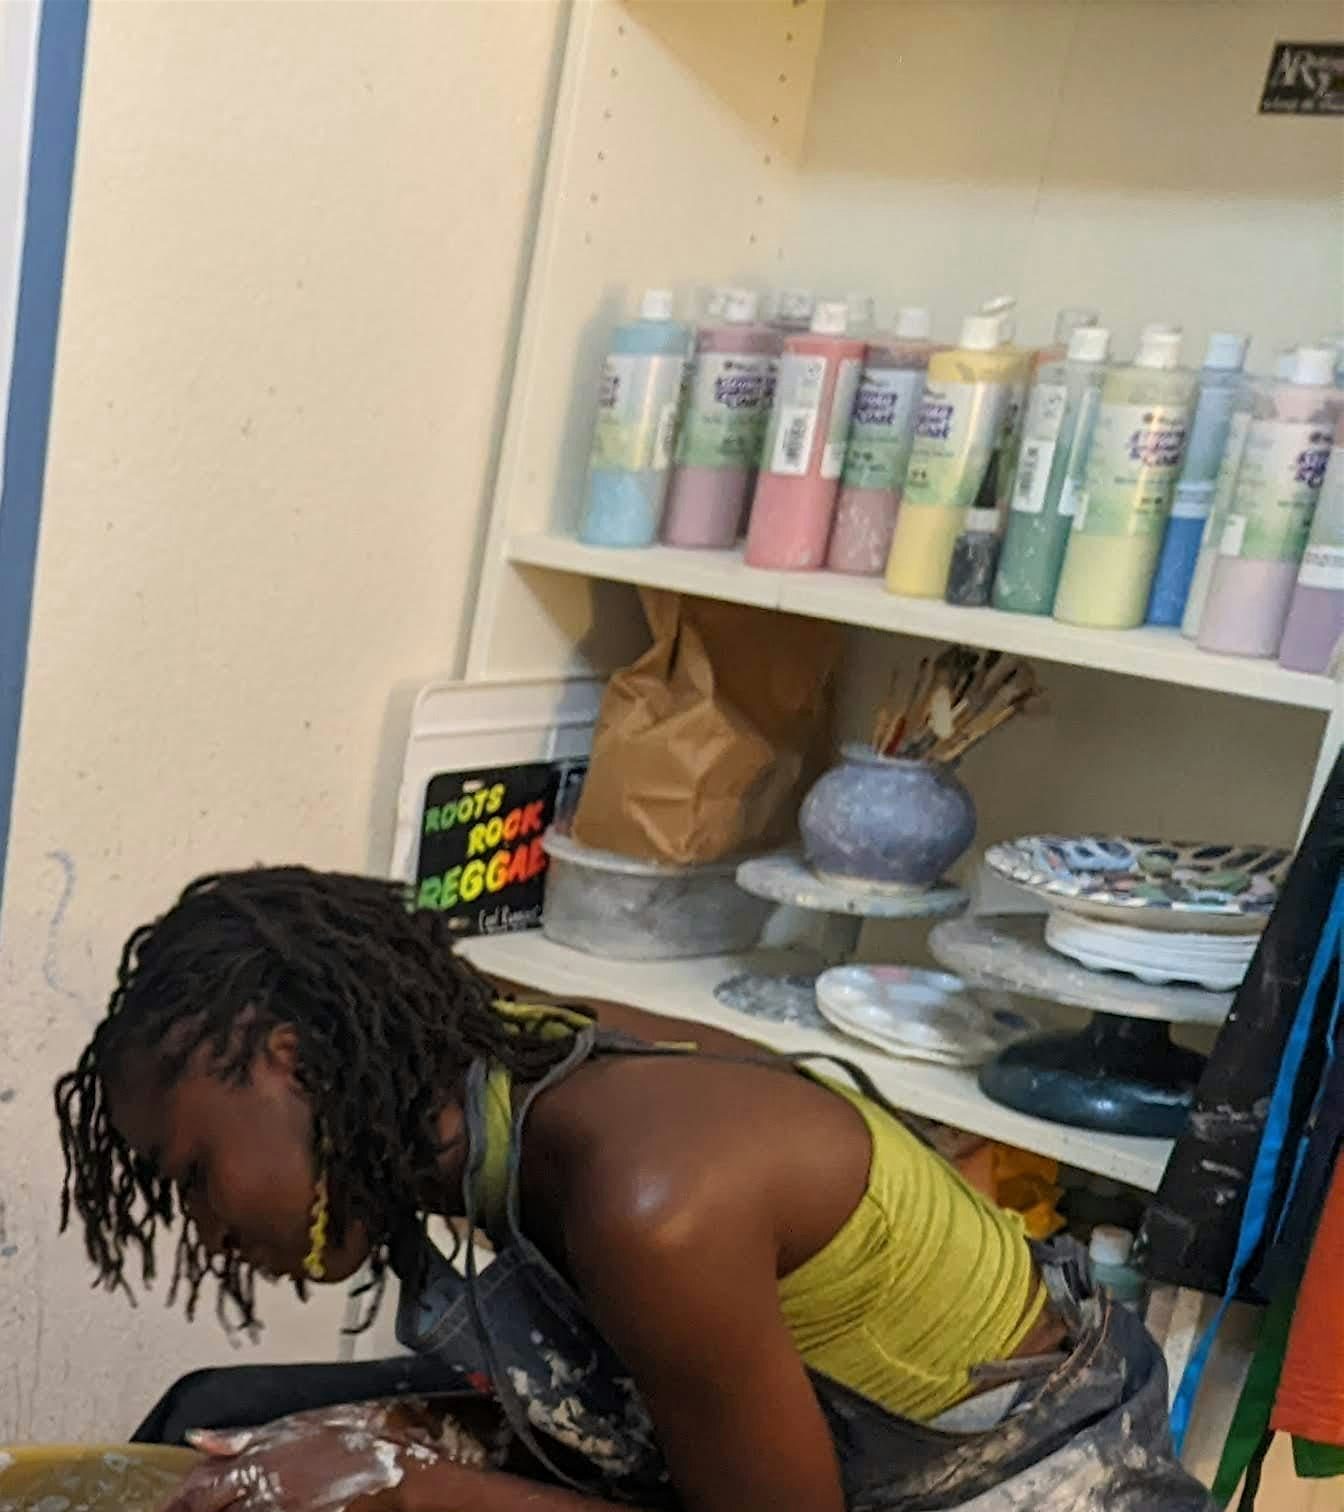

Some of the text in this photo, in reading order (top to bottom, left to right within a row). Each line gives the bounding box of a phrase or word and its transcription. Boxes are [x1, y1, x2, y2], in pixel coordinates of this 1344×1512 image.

[425, 783, 506, 834] ROOTS
[466, 800, 545, 858] ROCK
[417, 836, 547, 911] REGGAE
